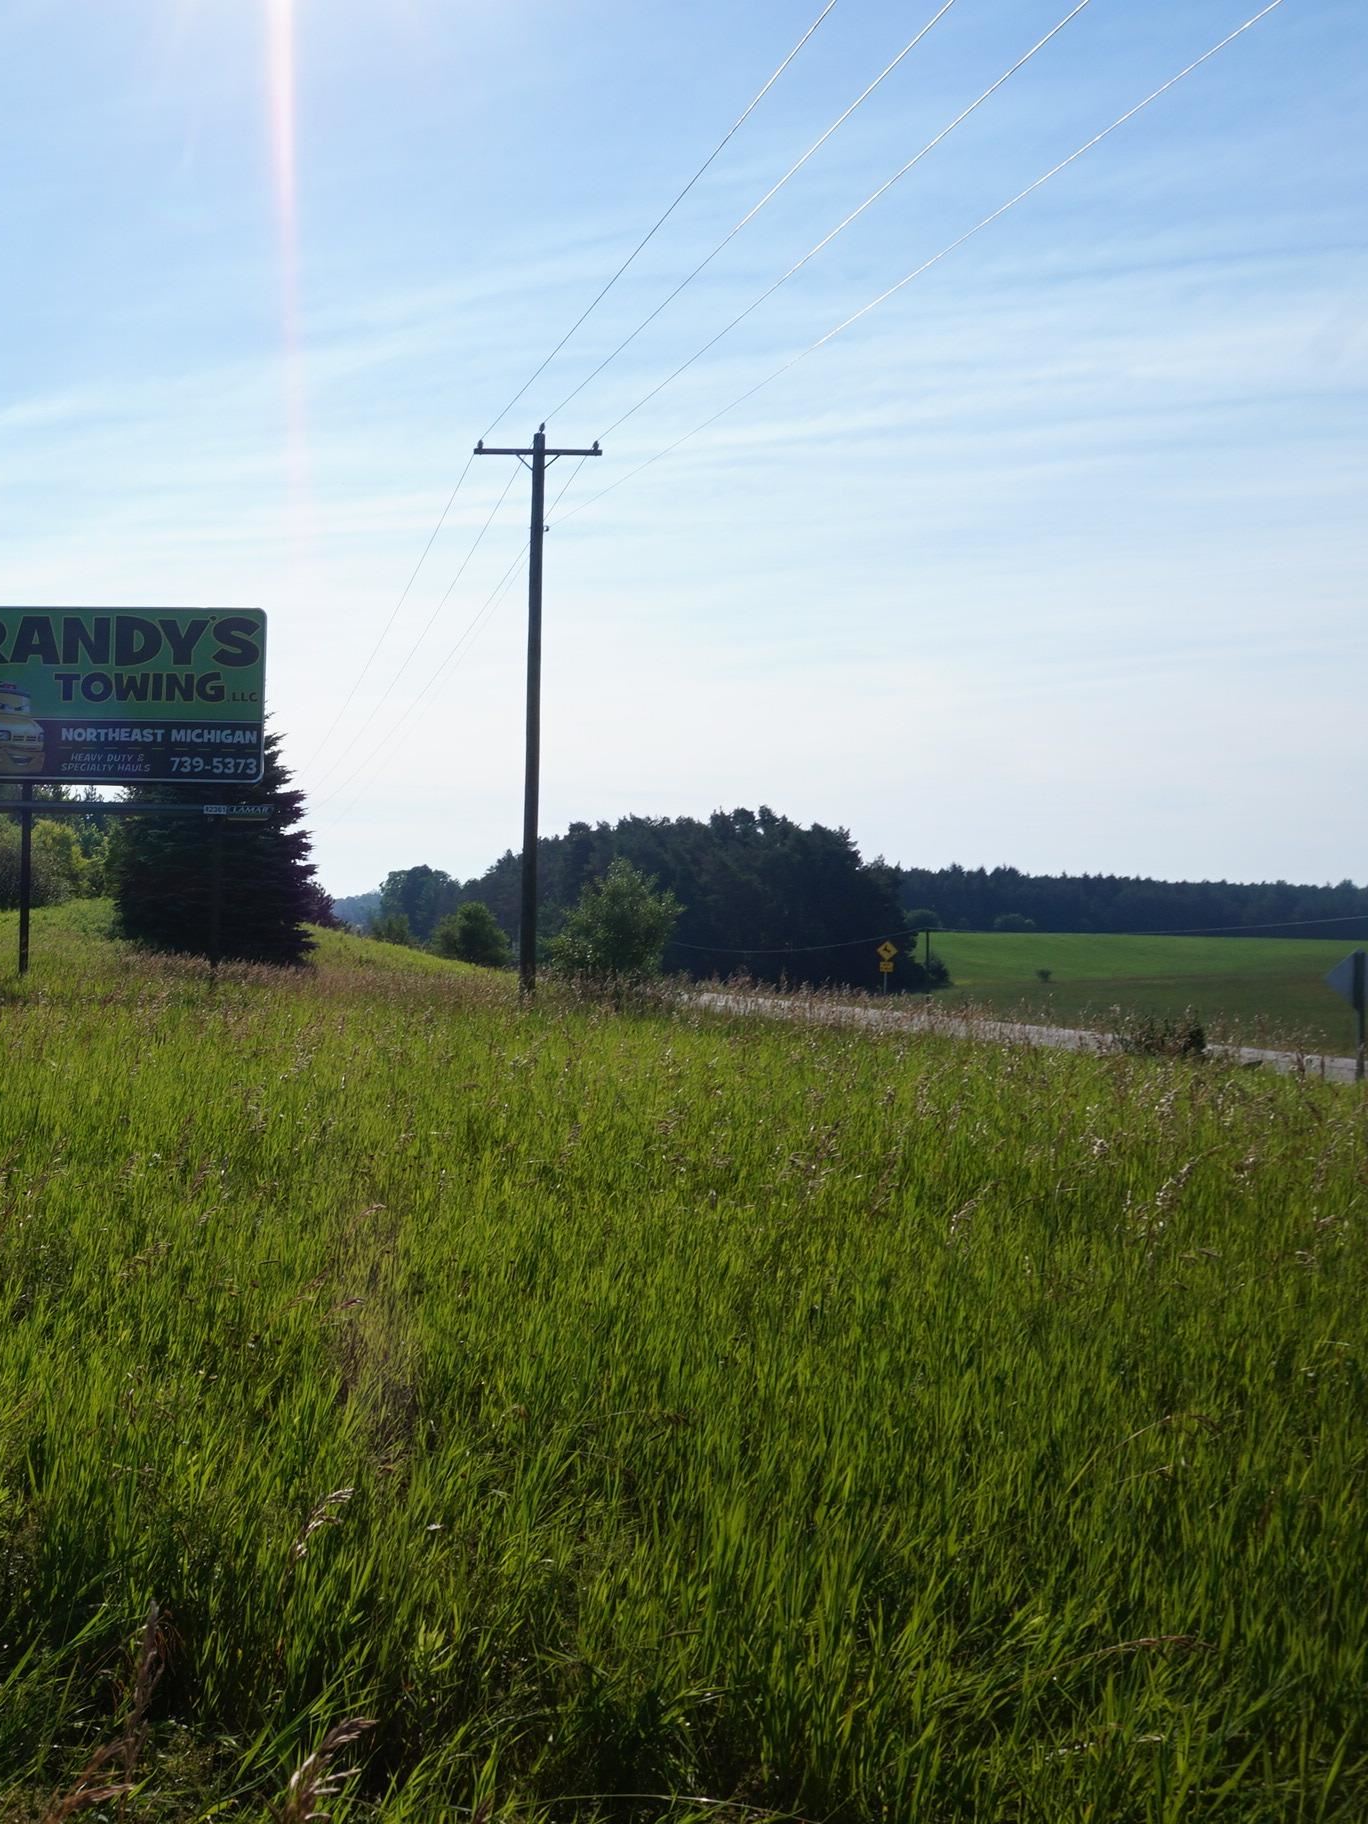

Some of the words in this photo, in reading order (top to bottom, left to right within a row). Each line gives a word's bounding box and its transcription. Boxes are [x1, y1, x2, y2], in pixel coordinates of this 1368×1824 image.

[54, 671, 225, 702] TOWING
[231, 691, 258, 702] LLC
[61, 727, 165, 742] NORTHEAST
[171, 729, 257, 744] MICHIGAN
[71, 752, 103, 762] HEAVY
[106, 753, 133, 762] DUTY
[137, 753, 145, 762] &
[170, 756, 257, 774] 739-5373
[61, 762, 114, 772] SPECIALTY
[118, 763, 151, 773] HAULS
